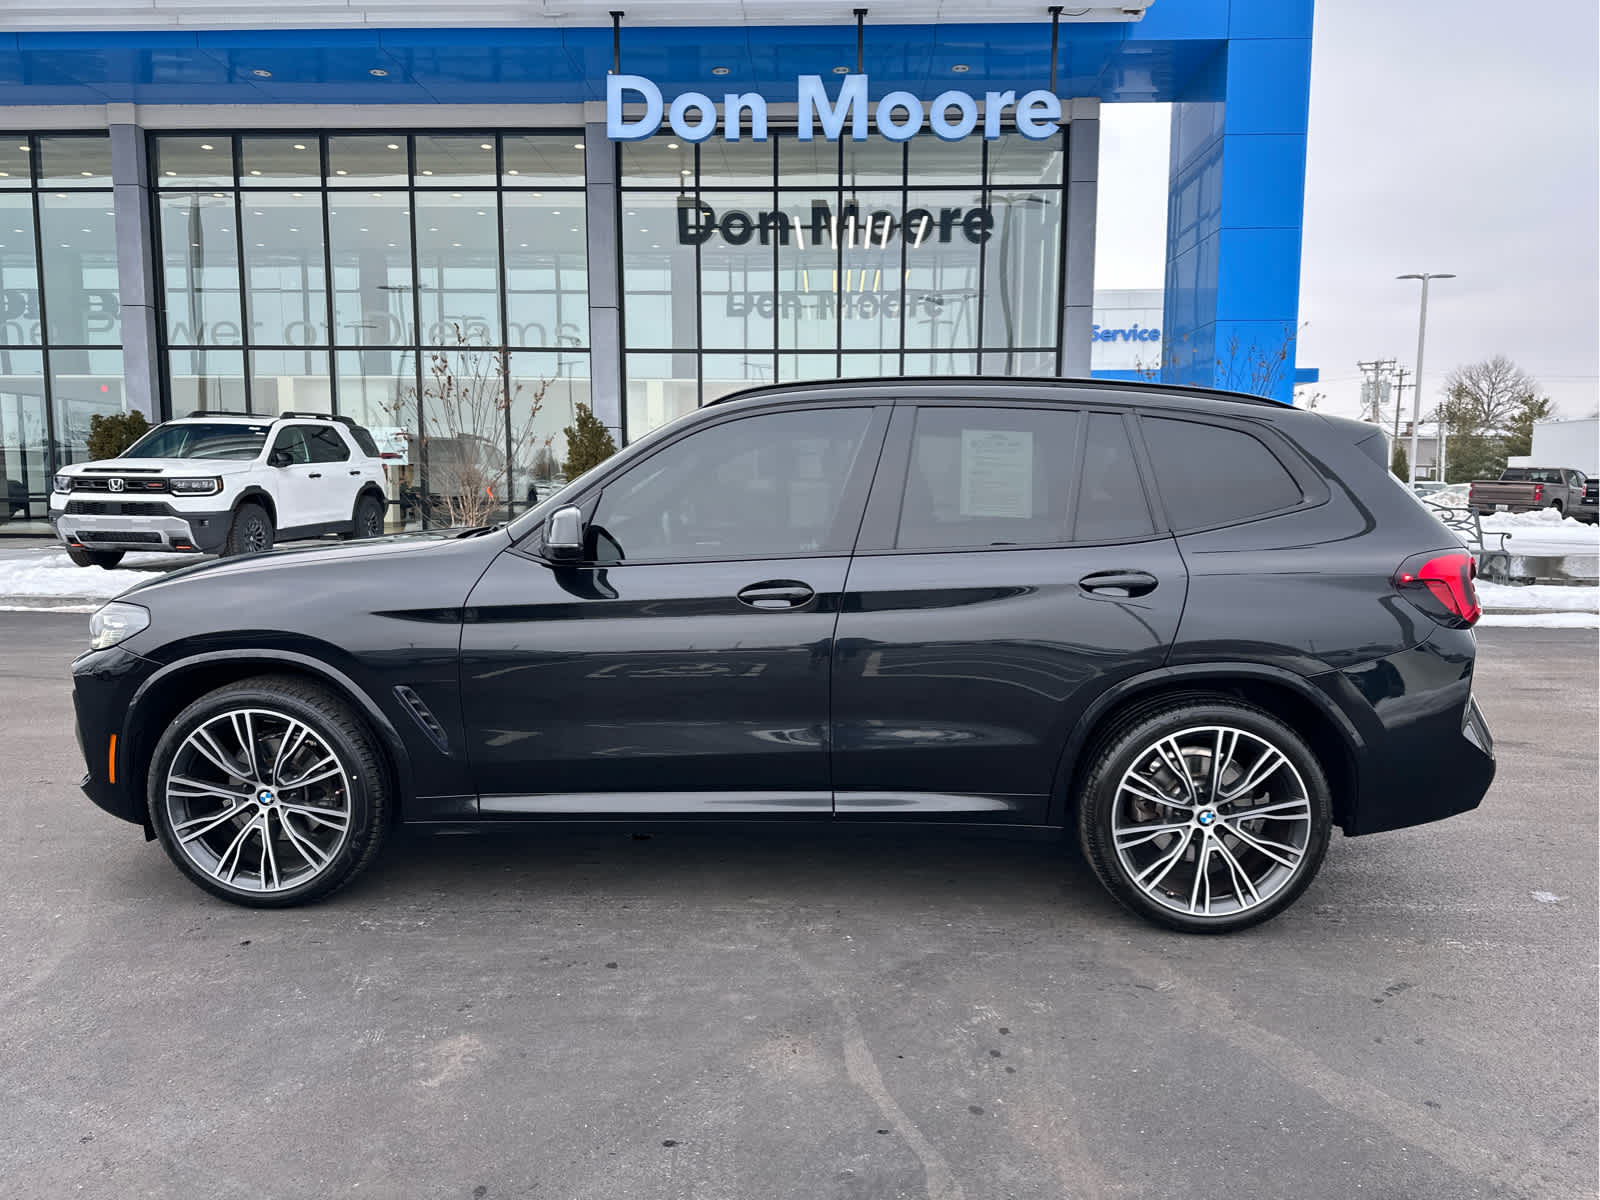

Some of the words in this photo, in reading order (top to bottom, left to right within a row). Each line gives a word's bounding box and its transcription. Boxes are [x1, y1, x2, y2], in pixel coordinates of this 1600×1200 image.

[606, 73, 768, 143] Don
[797, 73, 1061, 143] Moore
[676, 194, 790, 246] Don
[1091, 323, 1161, 342] Service
